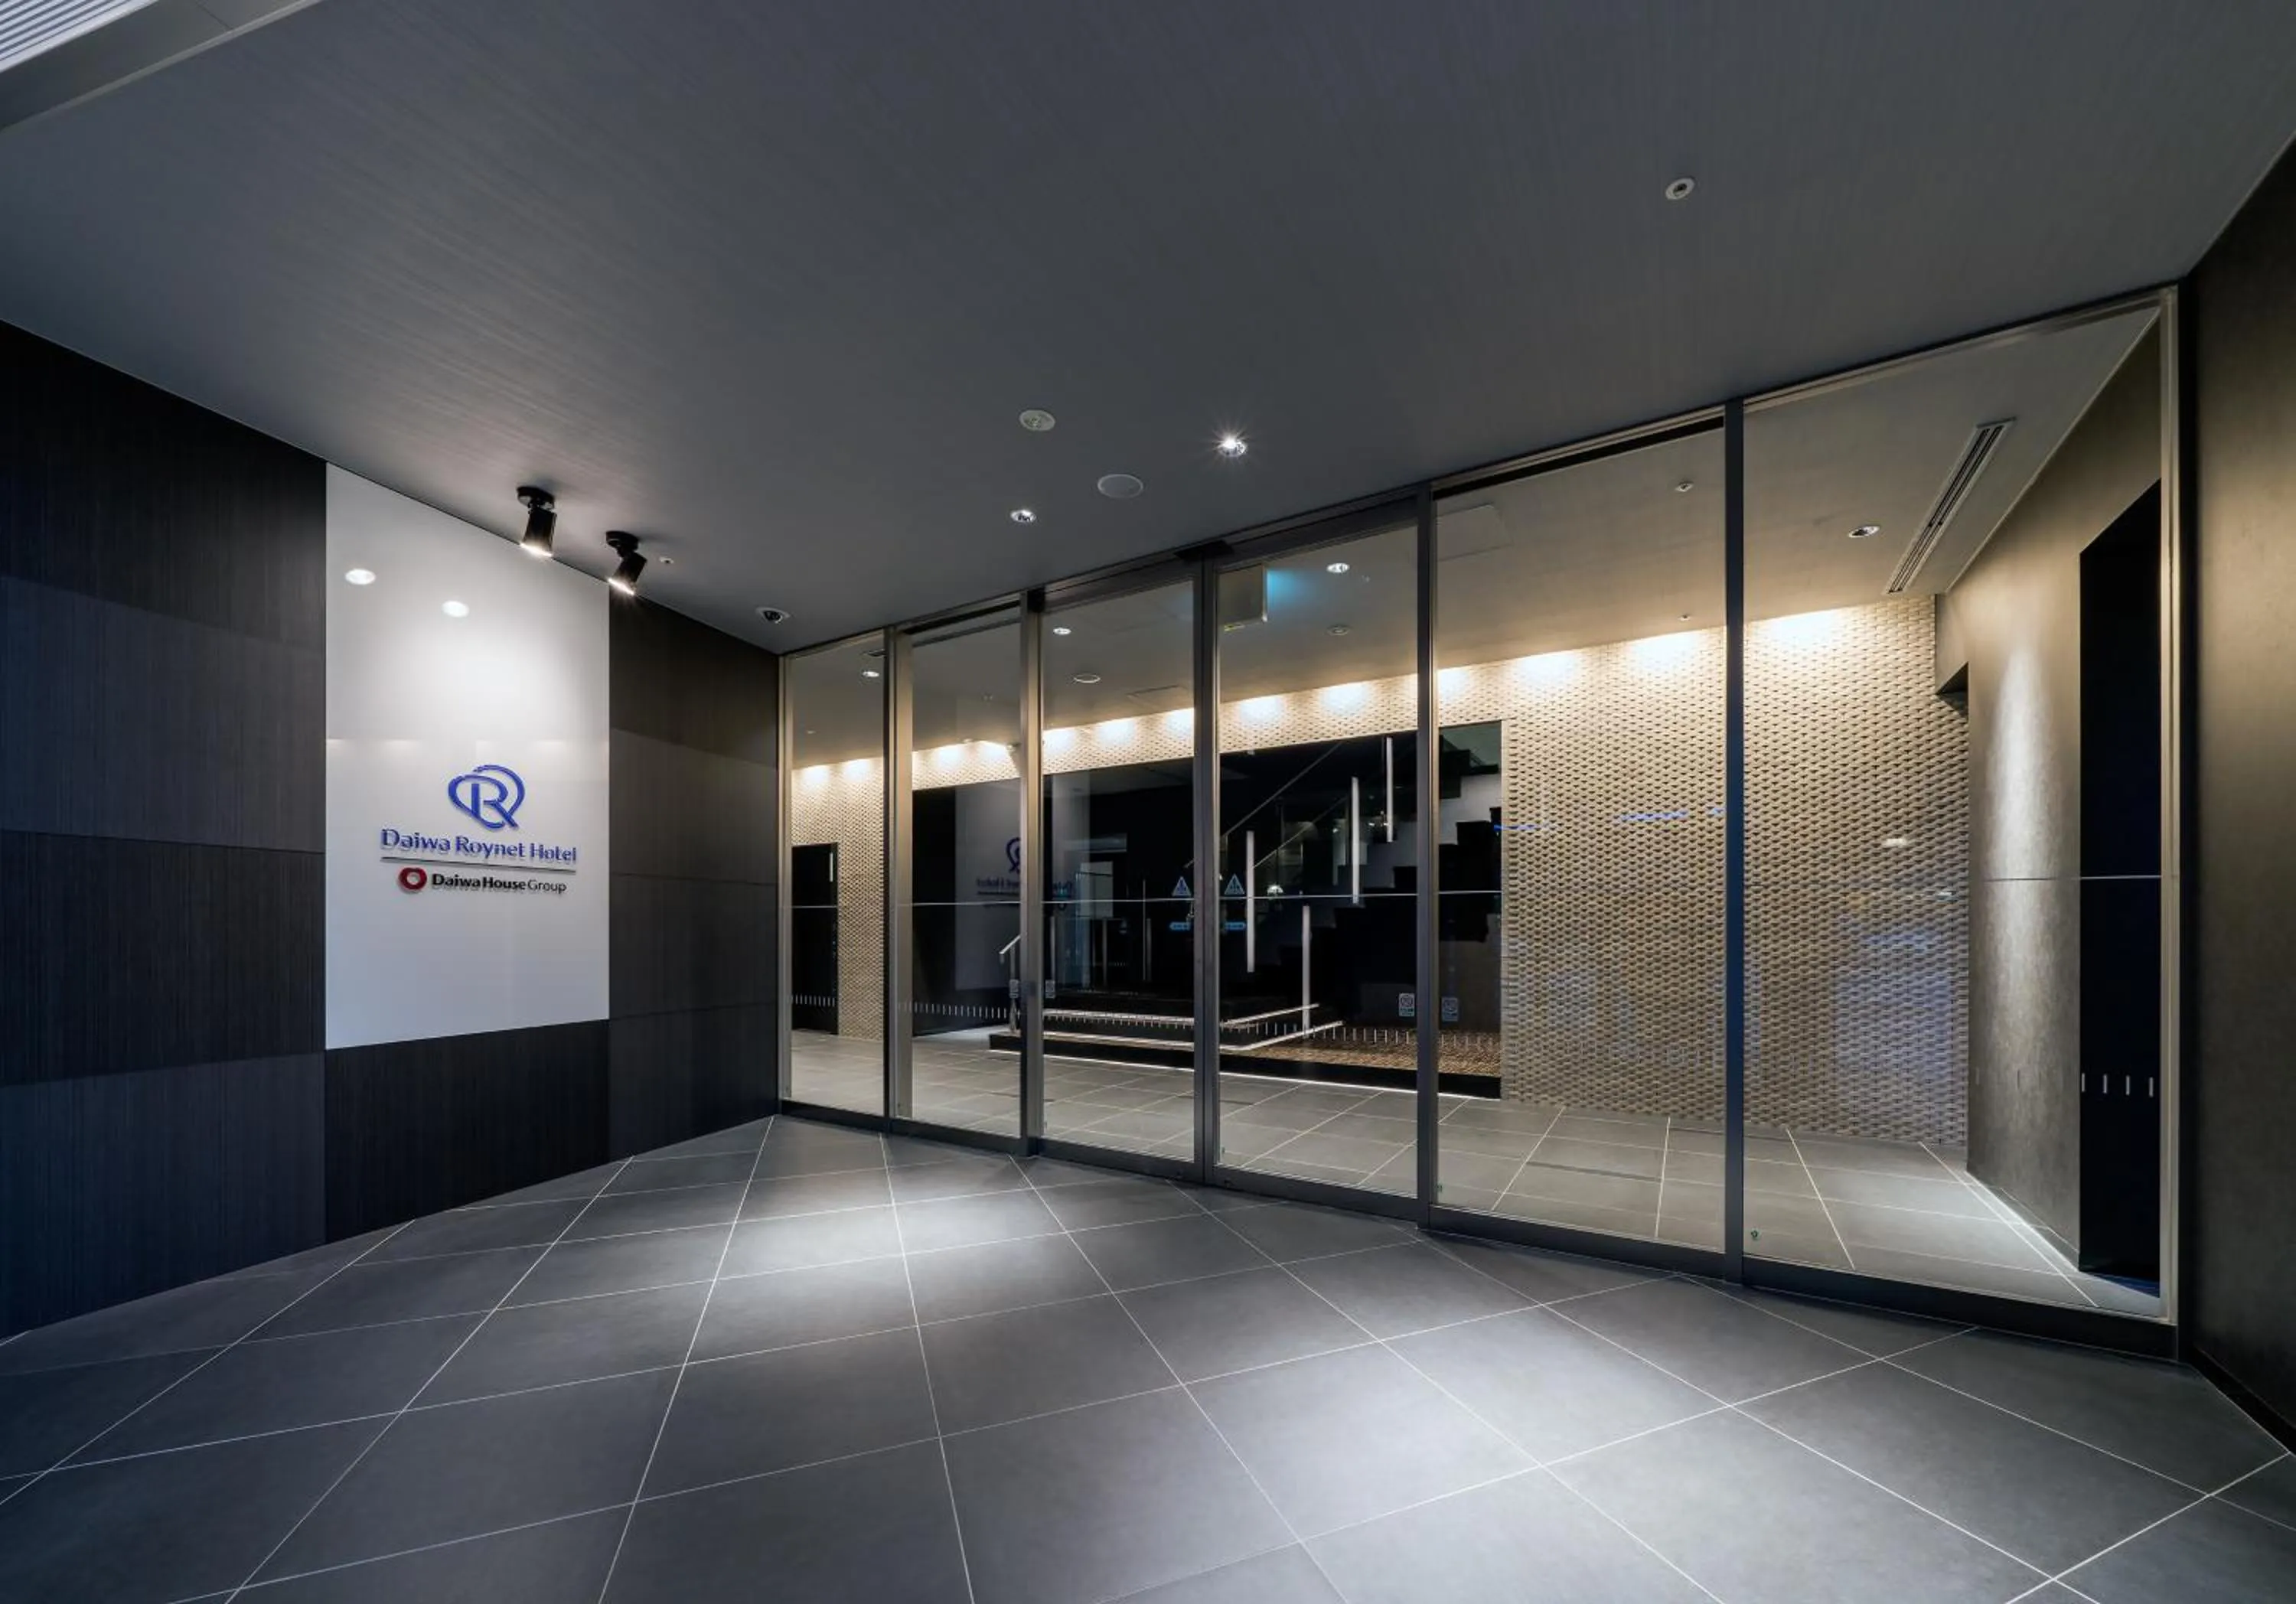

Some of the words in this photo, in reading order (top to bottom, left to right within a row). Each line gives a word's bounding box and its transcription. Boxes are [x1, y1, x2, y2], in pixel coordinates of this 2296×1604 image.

[381, 829, 451, 852] Daiwa
[455, 836, 526, 859] Roynet
[530, 843, 577, 862] Hotel
